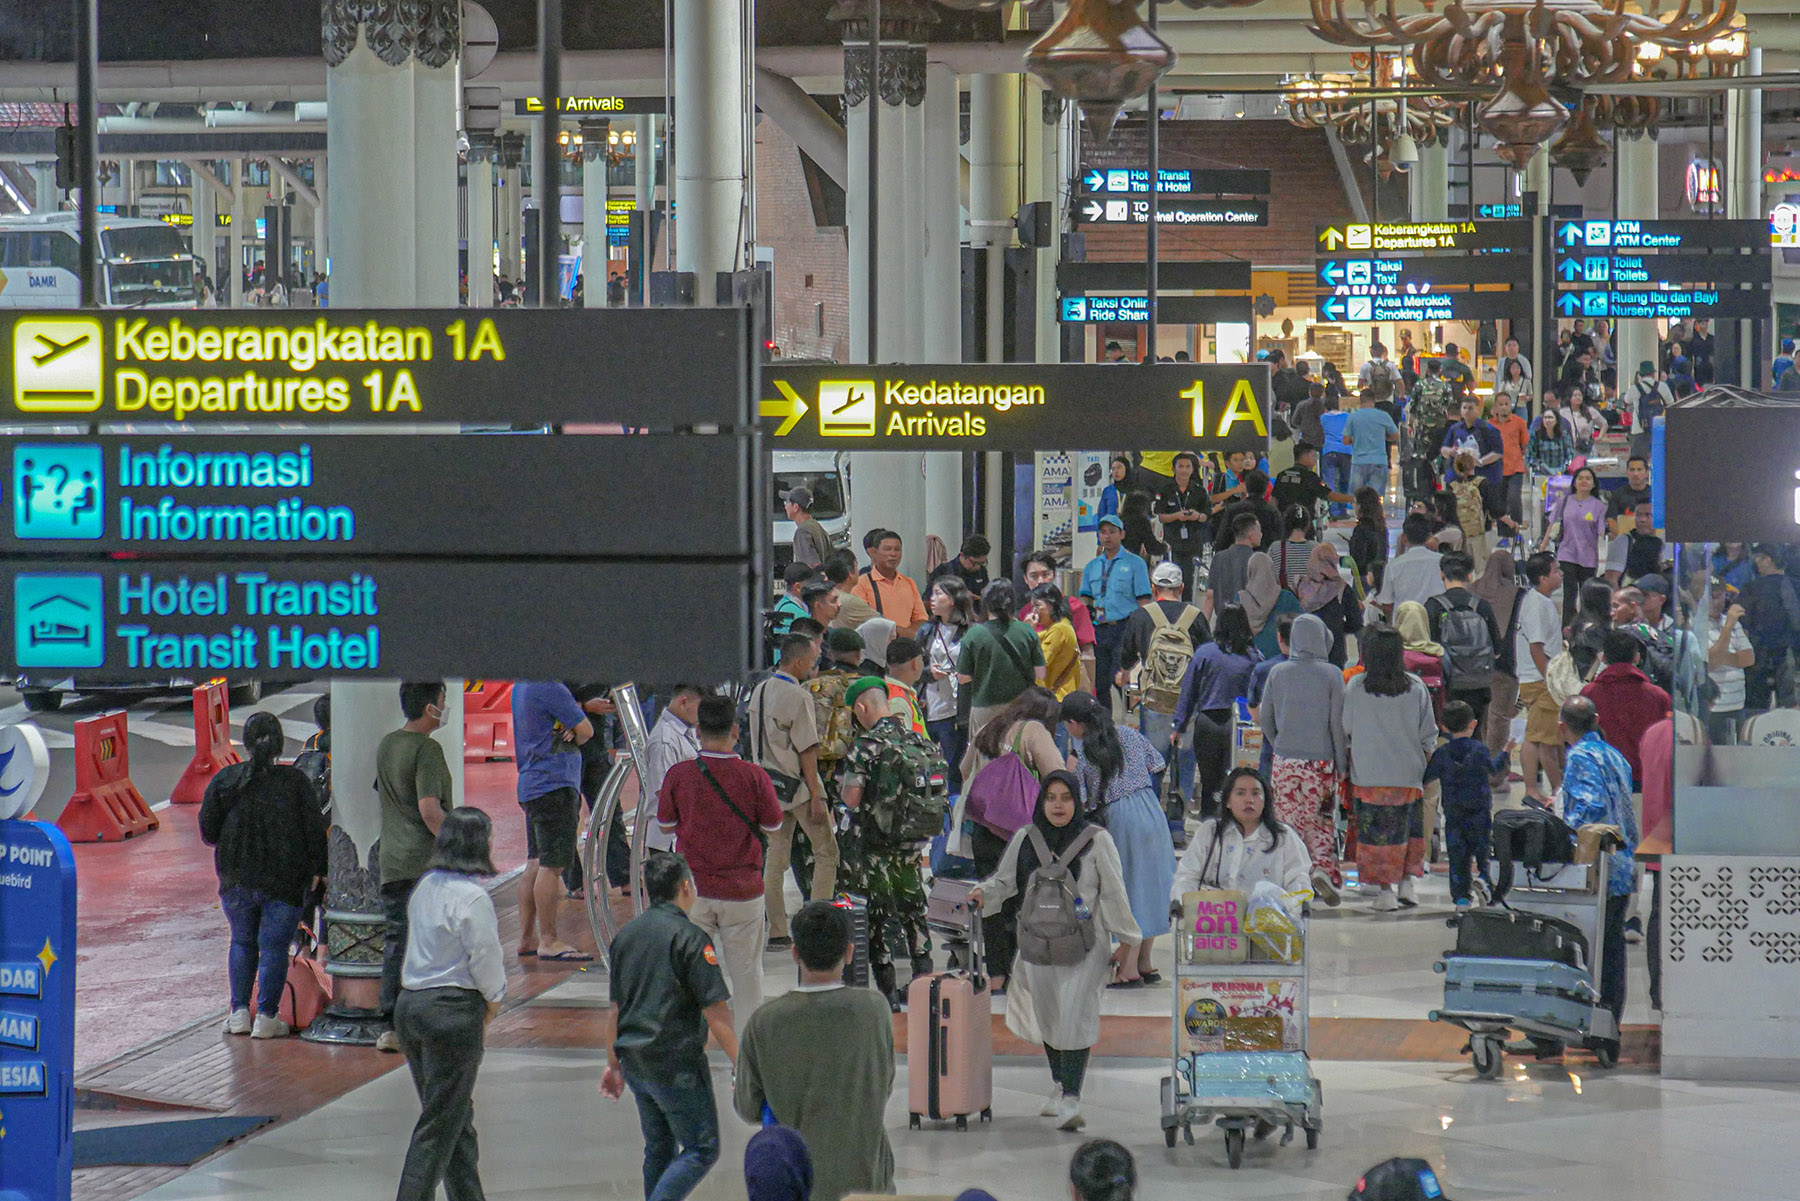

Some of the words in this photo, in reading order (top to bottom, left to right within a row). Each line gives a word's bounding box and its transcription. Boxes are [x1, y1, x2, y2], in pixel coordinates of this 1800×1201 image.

[566, 96, 624, 111] Arrivals
[1131, 170, 1151, 181] Hot
[1157, 170, 1191, 181] Transit
[1165, 182, 1191, 192] Hotel
[1175, 212, 1223, 224] Operation
[1225, 212, 1258, 223] Center
[1374, 223, 1457, 236] Keberangkatan
[1460, 221, 1476, 233] 1A
[1614, 221, 1640, 233] ATM
[1374, 236, 1436, 250] Departures
[1439, 236, 1455, 247] 1A
[1614, 234, 1640, 246] ATM
[1642, 234, 1681, 246] Center
[1374, 261, 1403, 272] Taksi
[1613, 257, 1643, 268] Toilet
[30, 276, 57, 287] DAMRI
[1375, 274, 1397, 284] Taxi
[1613, 269, 1648, 281] Toilets
[1090, 297, 1118, 309] Taksi
[1375, 296, 1401, 307] Area
[1404, 294, 1452, 307] Merokok
[1612, 292, 1649, 305] Ruang
[1651, 291, 1668, 303] Ibu
[1671, 291, 1692, 303] dan
[1694, 291, 1718, 305] Bayi
[1090, 310, 1116, 321] Ride
[1375, 309, 1424, 321] Smoking
[1426, 309, 1452, 320] Area
[1612, 306, 1655, 318] Nursery
[1658, 305, 1691, 316] Room
[115, 317, 433, 371] Keberangkatan
[445, 317, 505, 361] 1A
[115, 367, 350, 421] Departures
[362, 367, 422, 411] 1A
[884, 380, 1046, 411] Kedatangan
[1178, 378, 1268, 438] 1A
[885, 412, 987, 438] Arrivals
[119, 443, 313, 488] Informasi
[119, 495, 355, 541] Information
[118, 572, 229, 616] Hotel
[235, 571, 379, 616] Transit
[116, 624, 259, 669] Transit
[268, 624, 380, 669] Hotel
[10, 846, 53, 867] POINT
[1197, 901, 1237, 916] McD
[1195, 916, 1238, 934] on
[1, 968, 36, 989] DAR
